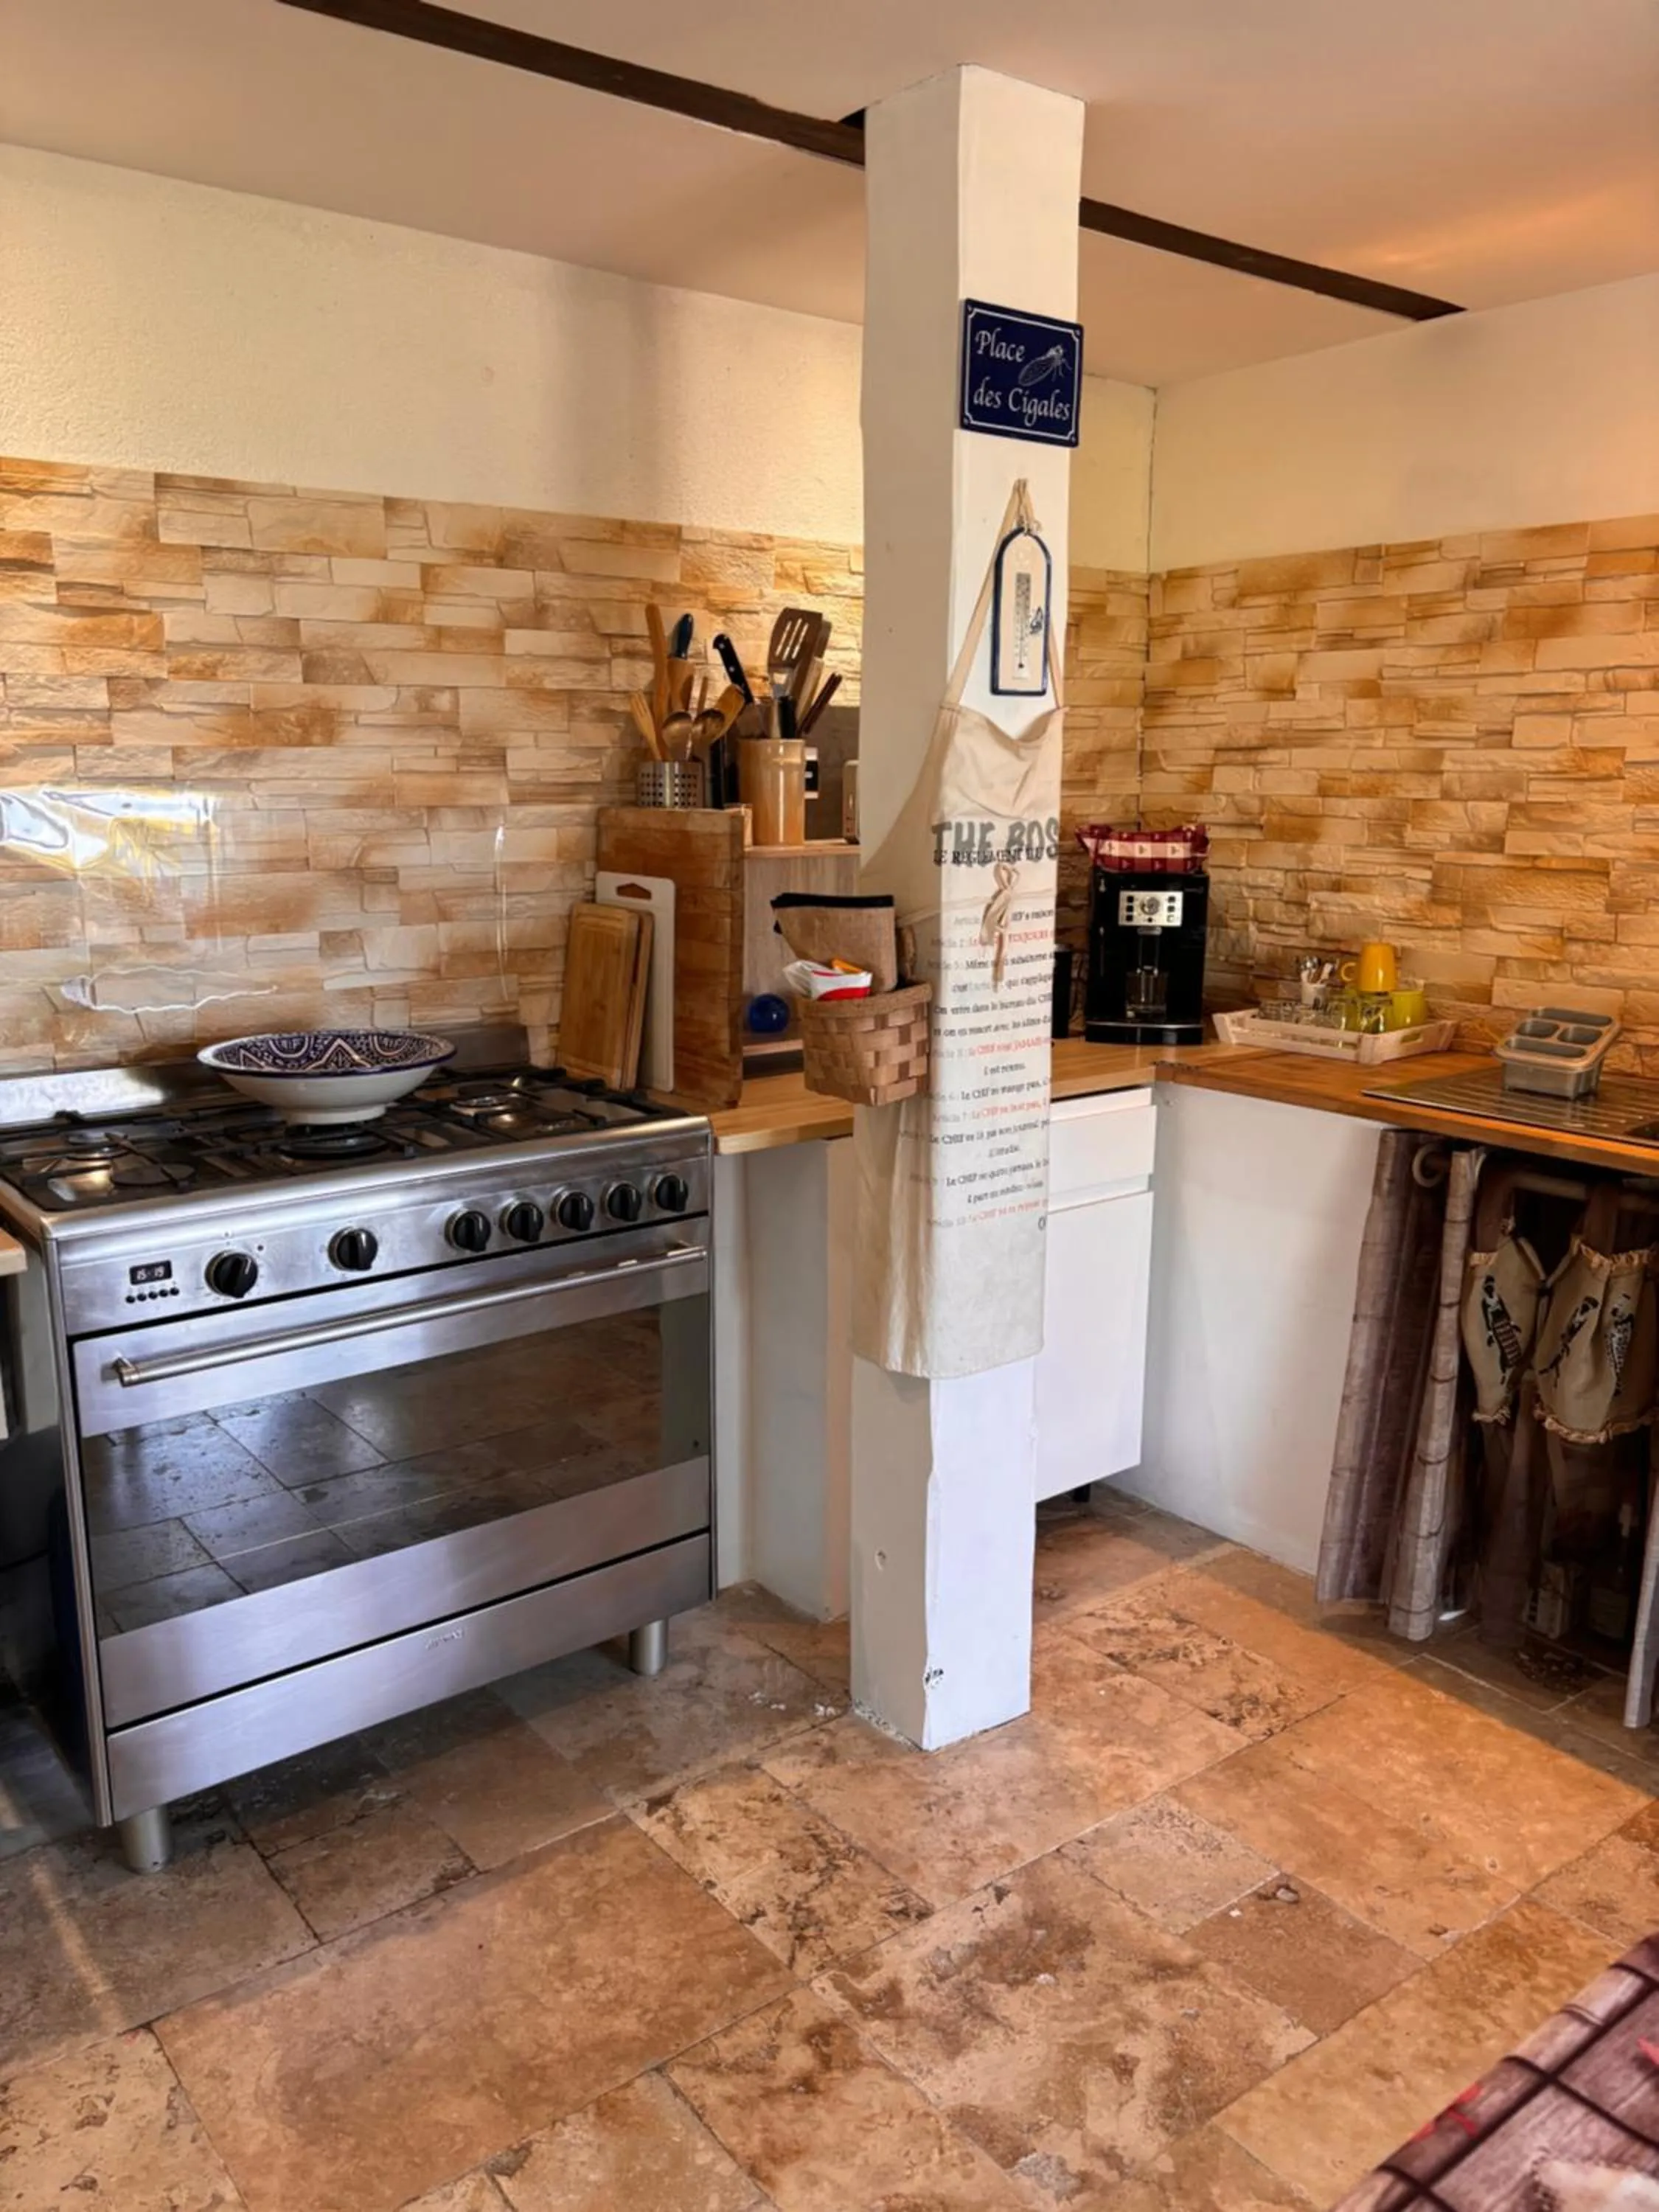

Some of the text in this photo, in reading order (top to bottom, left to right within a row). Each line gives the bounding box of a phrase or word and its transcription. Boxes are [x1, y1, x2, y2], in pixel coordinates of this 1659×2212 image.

[975, 327, 1025, 362] Place
[973, 376, 1070, 427] des Cigales
[931, 821, 995, 864] THE
